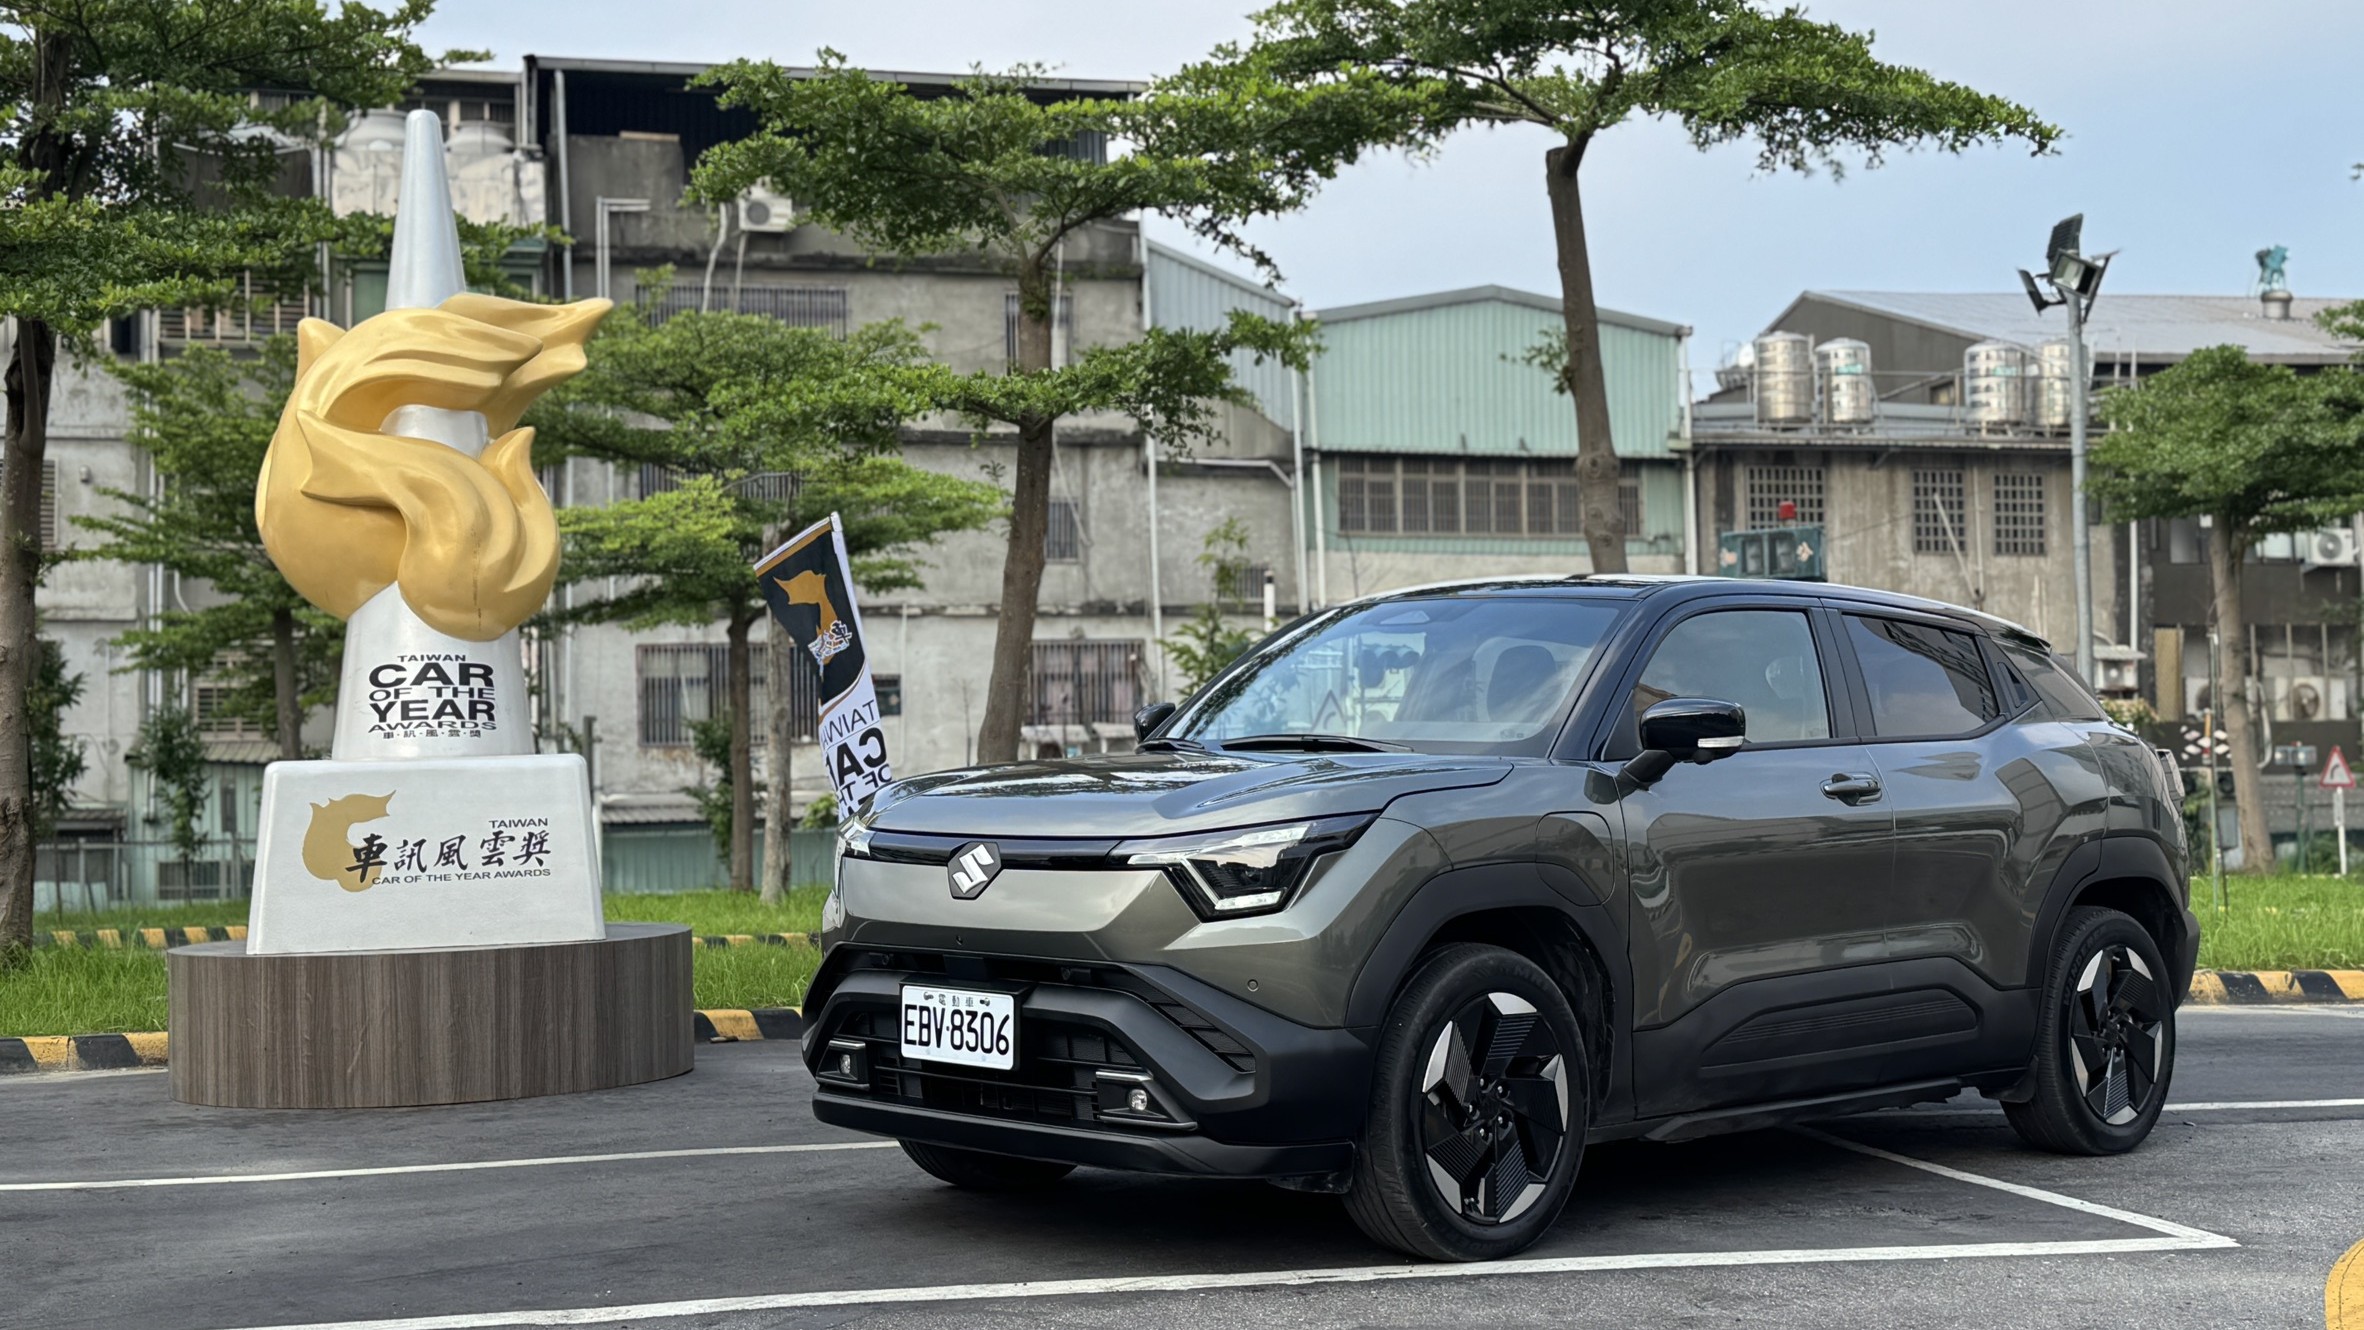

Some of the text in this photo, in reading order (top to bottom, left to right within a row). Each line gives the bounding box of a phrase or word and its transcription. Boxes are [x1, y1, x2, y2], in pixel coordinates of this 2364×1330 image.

[397, 654, 466, 662] TAIWAN
[369, 662, 494, 688] CAR
[369, 686, 496, 702] OF THE
[369, 699, 495, 723] YEAR
[368, 720, 497, 733] AWARDS
[489, 817, 549, 829] TAIWAN
[372, 868, 552, 885] CAR OF THE YEAR AWARDS
